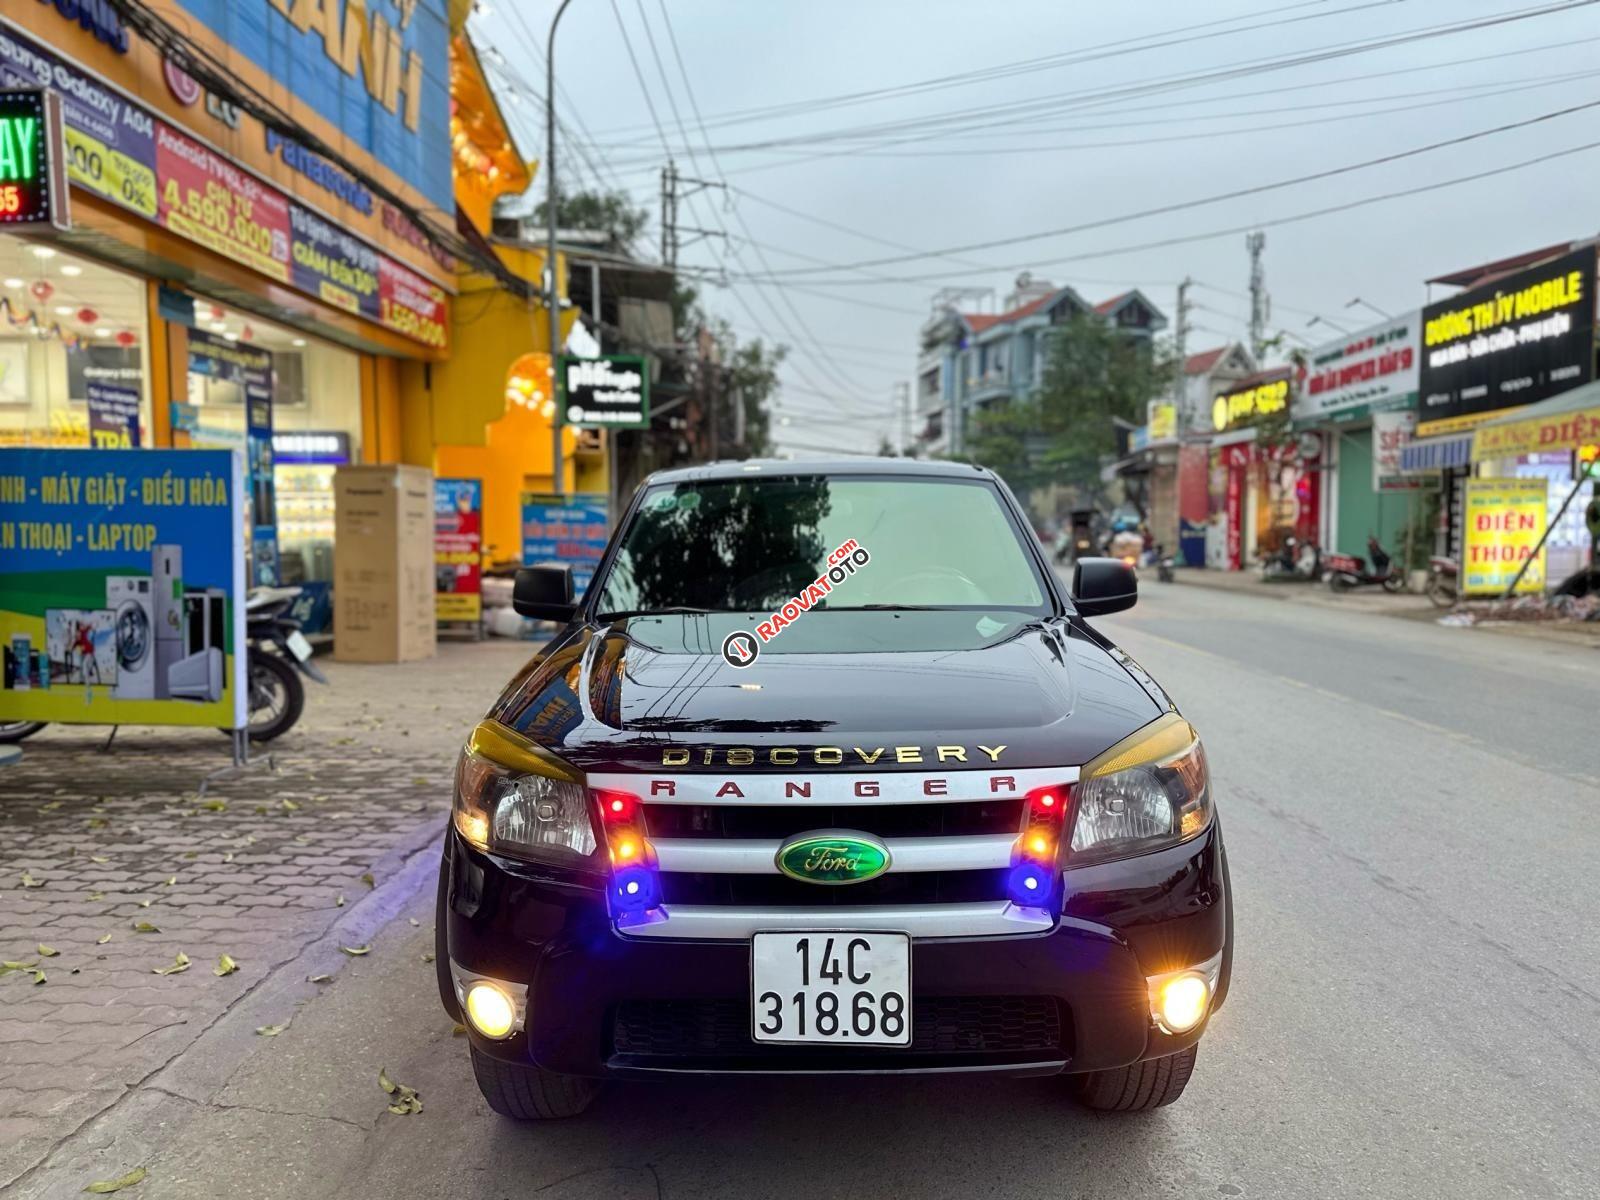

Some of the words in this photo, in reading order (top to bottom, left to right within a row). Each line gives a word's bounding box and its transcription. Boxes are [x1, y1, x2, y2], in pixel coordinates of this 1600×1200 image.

[54, 65, 120, 126] Galaxy
[123, 105, 153, 139] A04
[1514, 270, 1582, 319] MOBILE
[41, 470, 81, 504] MÁY
[85, 471, 126, 511] GIẶT
[18, 522, 72, 557] THOẠI
[87, 523, 157, 551] LAPTOP
[1477, 511, 1534, 533] ĐIỆN
[662, 745, 1008, 766] DISCOVERY
[650, 776, 1016, 798] RANGER
[804, 847, 861, 872] Ford
[796, 938, 872, 986] 14C
[759, 991, 905, 1038] 318.68
